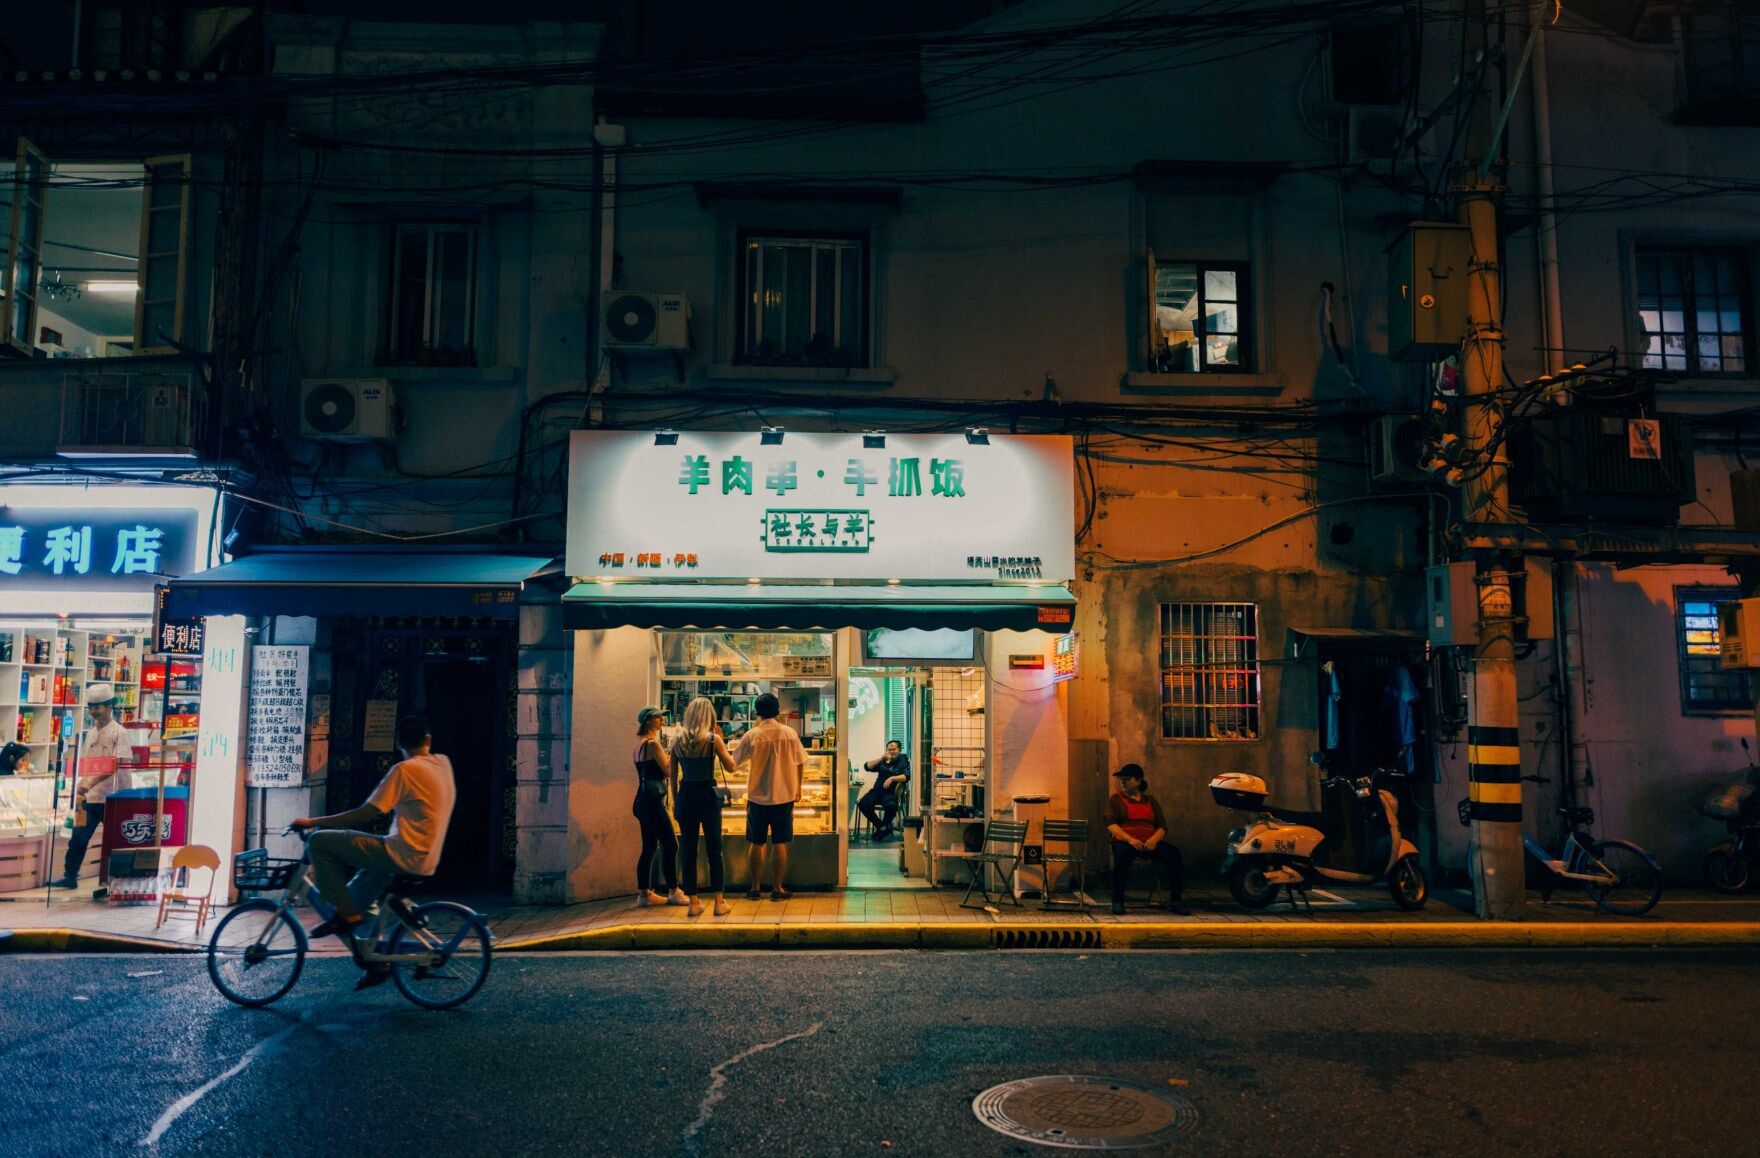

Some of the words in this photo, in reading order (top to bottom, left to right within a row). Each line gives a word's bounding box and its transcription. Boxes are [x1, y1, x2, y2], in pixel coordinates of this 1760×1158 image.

[678, 454, 966, 498] 羊肉串·手抓饭
[770, 512, 865, 539] 社长与羊
[161, 623, 203, 650] 便利店
